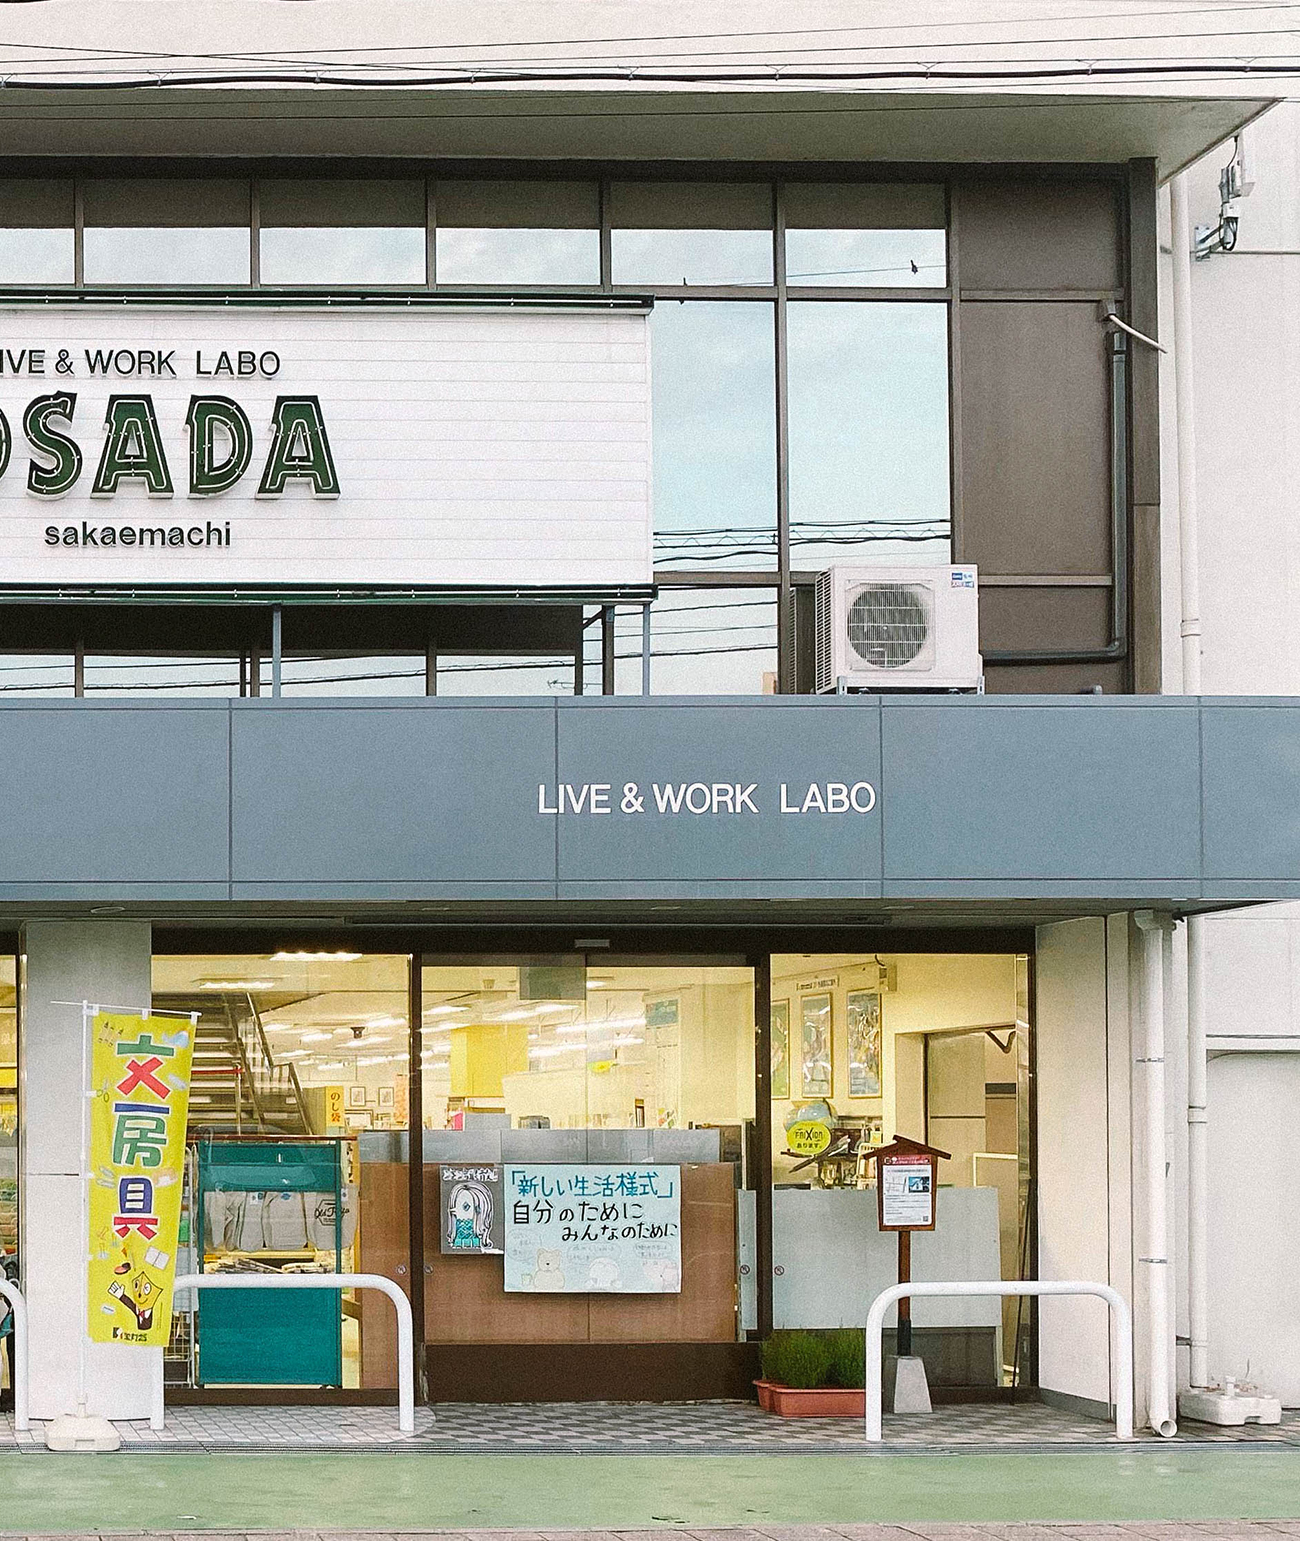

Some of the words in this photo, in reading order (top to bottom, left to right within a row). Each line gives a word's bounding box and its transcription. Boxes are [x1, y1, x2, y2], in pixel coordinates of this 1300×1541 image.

[55, 349, 75, 376] &
[85, 350, 177, 377] WORK
[196, 351, 281, 378] LABO
[44, 521, 232, 548] sakaemachi
[538, 784, 611, 814] LIVE
[620, 782, 645, 814] &
[653, 783, 759, 814] WORK
[780, 781, 876, 814] LABO
[111, 1033, 175, 1241] 文房具
[511, 1170, 674, 1199] 「新しい生活様式」
[513, 1199, 645, 1225] 自分のために
[561, 1222, 678, 1241] みんなのために
